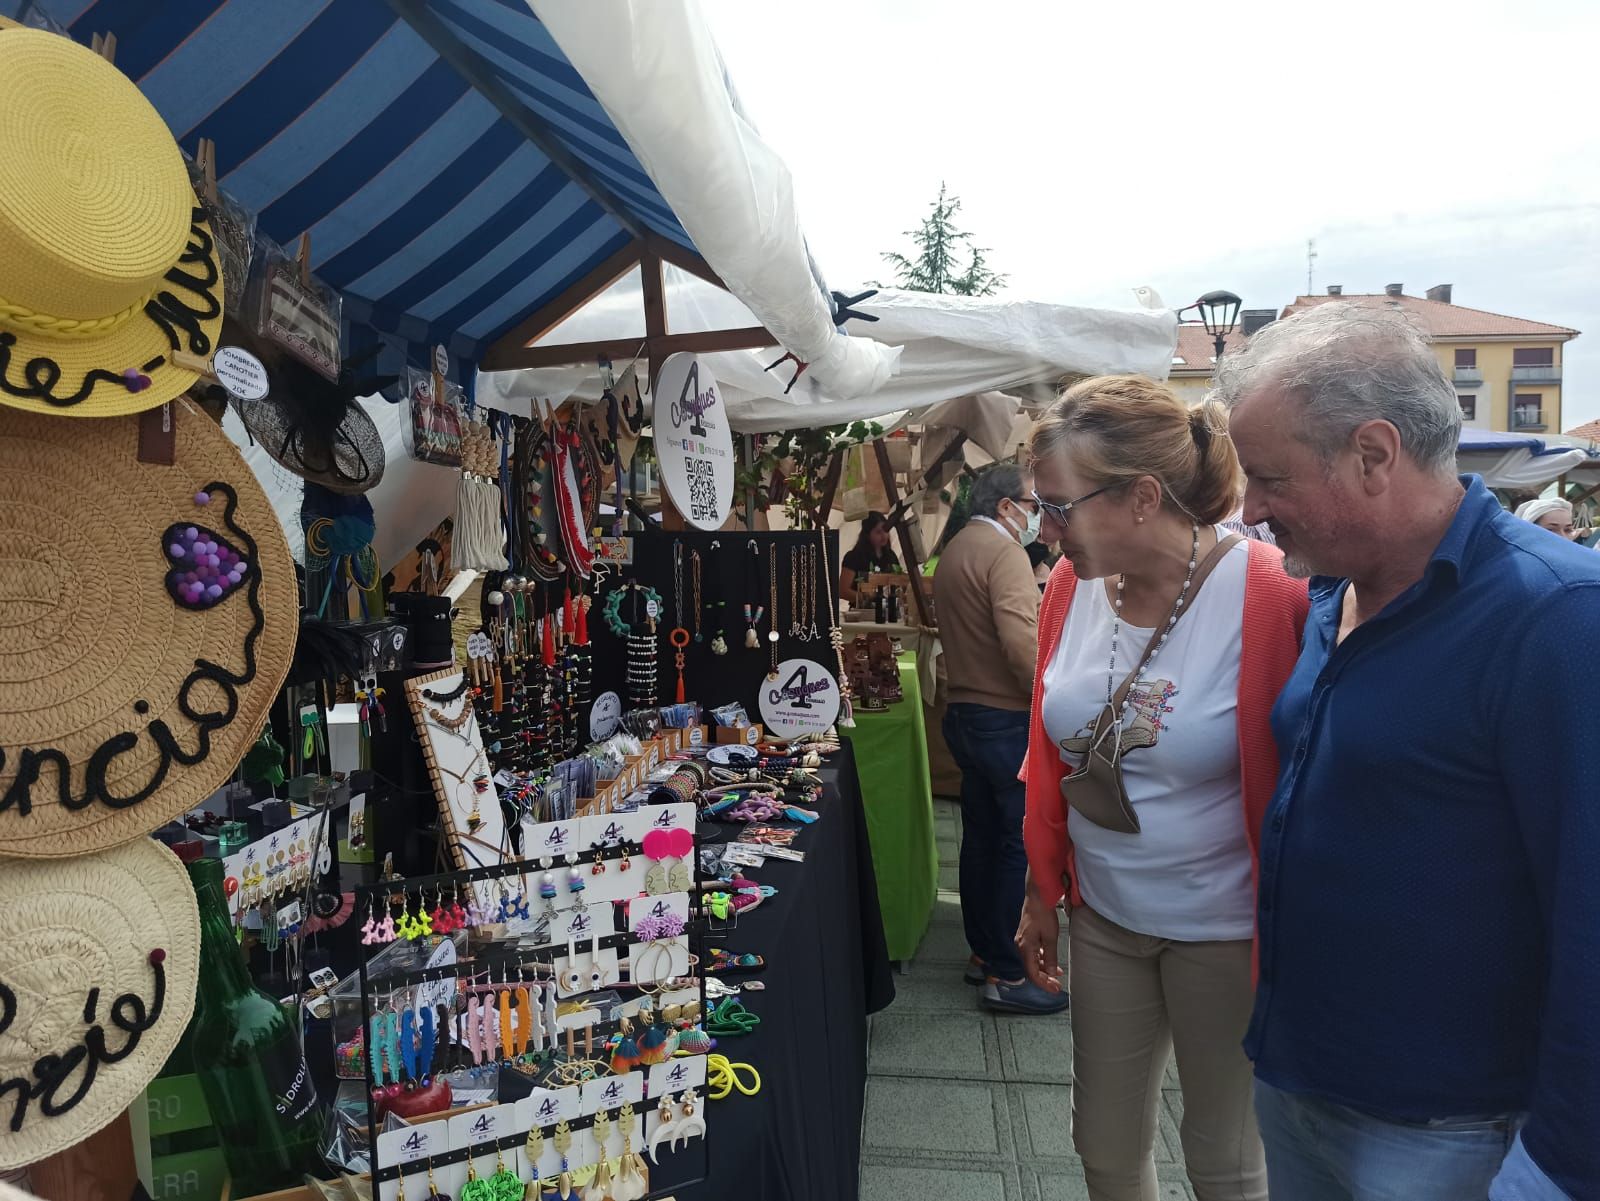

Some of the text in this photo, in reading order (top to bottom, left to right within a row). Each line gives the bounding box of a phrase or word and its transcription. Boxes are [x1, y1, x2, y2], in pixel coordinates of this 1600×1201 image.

[222, 349, 261, 371] SOMBRERO
[224, 360, 259, 379] CANOTIER
[216, 368, 264, 392] personalizado
[232, 384, 247, 396] 20€
[679, 360, 707, 438] 4
[781, 665, 813, 709] 4
[659, 809, 669, 826] 4
[549, 826, 563, 844] 4
[604, 821, 617, 839] 4
[652, 901, 664, 917] 4
[572, 914, 586, 931] 4
[670, 1063, 682, 1080] 4
[604, 1081, 618, 1098] 4
[540, 1098, 554, 1115] 4
[475, 1114, 489, 1131] 4
[406, 1131, 420, 1150] 4
